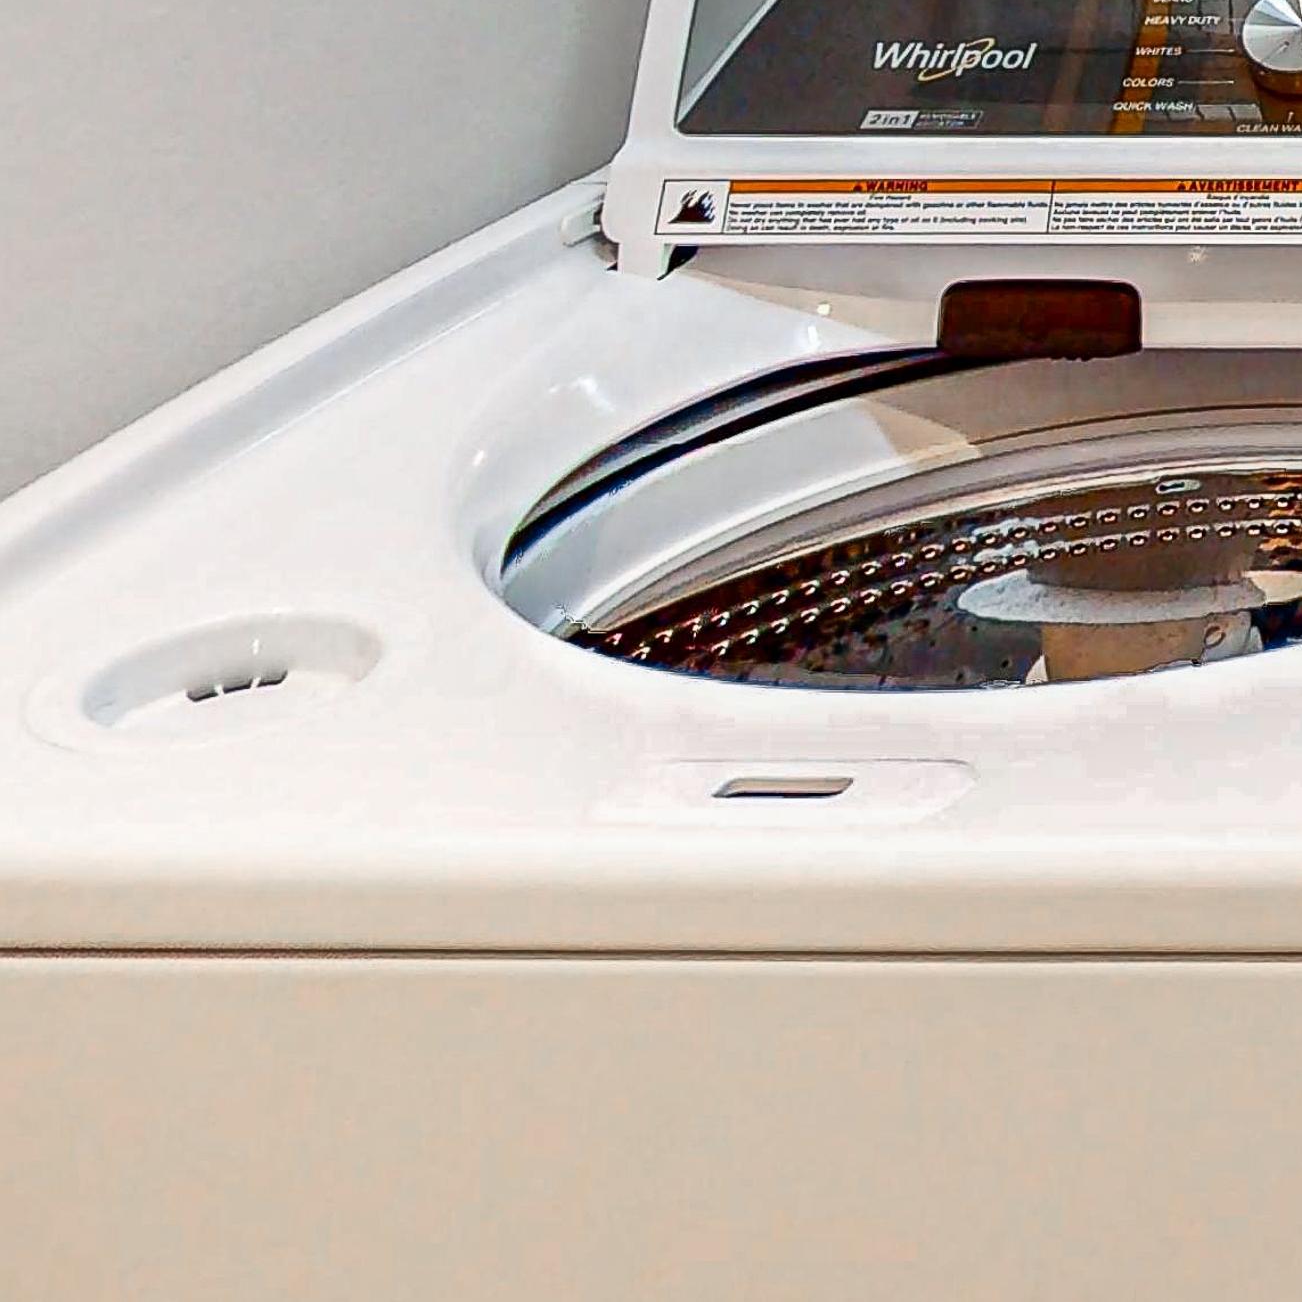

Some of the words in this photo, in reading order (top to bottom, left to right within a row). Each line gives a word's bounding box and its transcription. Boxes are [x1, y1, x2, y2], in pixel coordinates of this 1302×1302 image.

[1144, 16, 1187, 26] HEAVY
[1187, 16, 1221, 26] DUTY
[1135, 46, 1183, 56] WHITES
[873, 39, 1038, 80] Whirlpool
[1122, 77, 1175, 87] COLORS
[1113, 102, 1152, 111] QUICK
[1155, 101, 1194, 111] WASH
[1236, 124, 1279, 133] CLEAN
[866, 181, 928, 193] WARNING
[1188, 181, 1299, 192] AVERTISSEMENT
